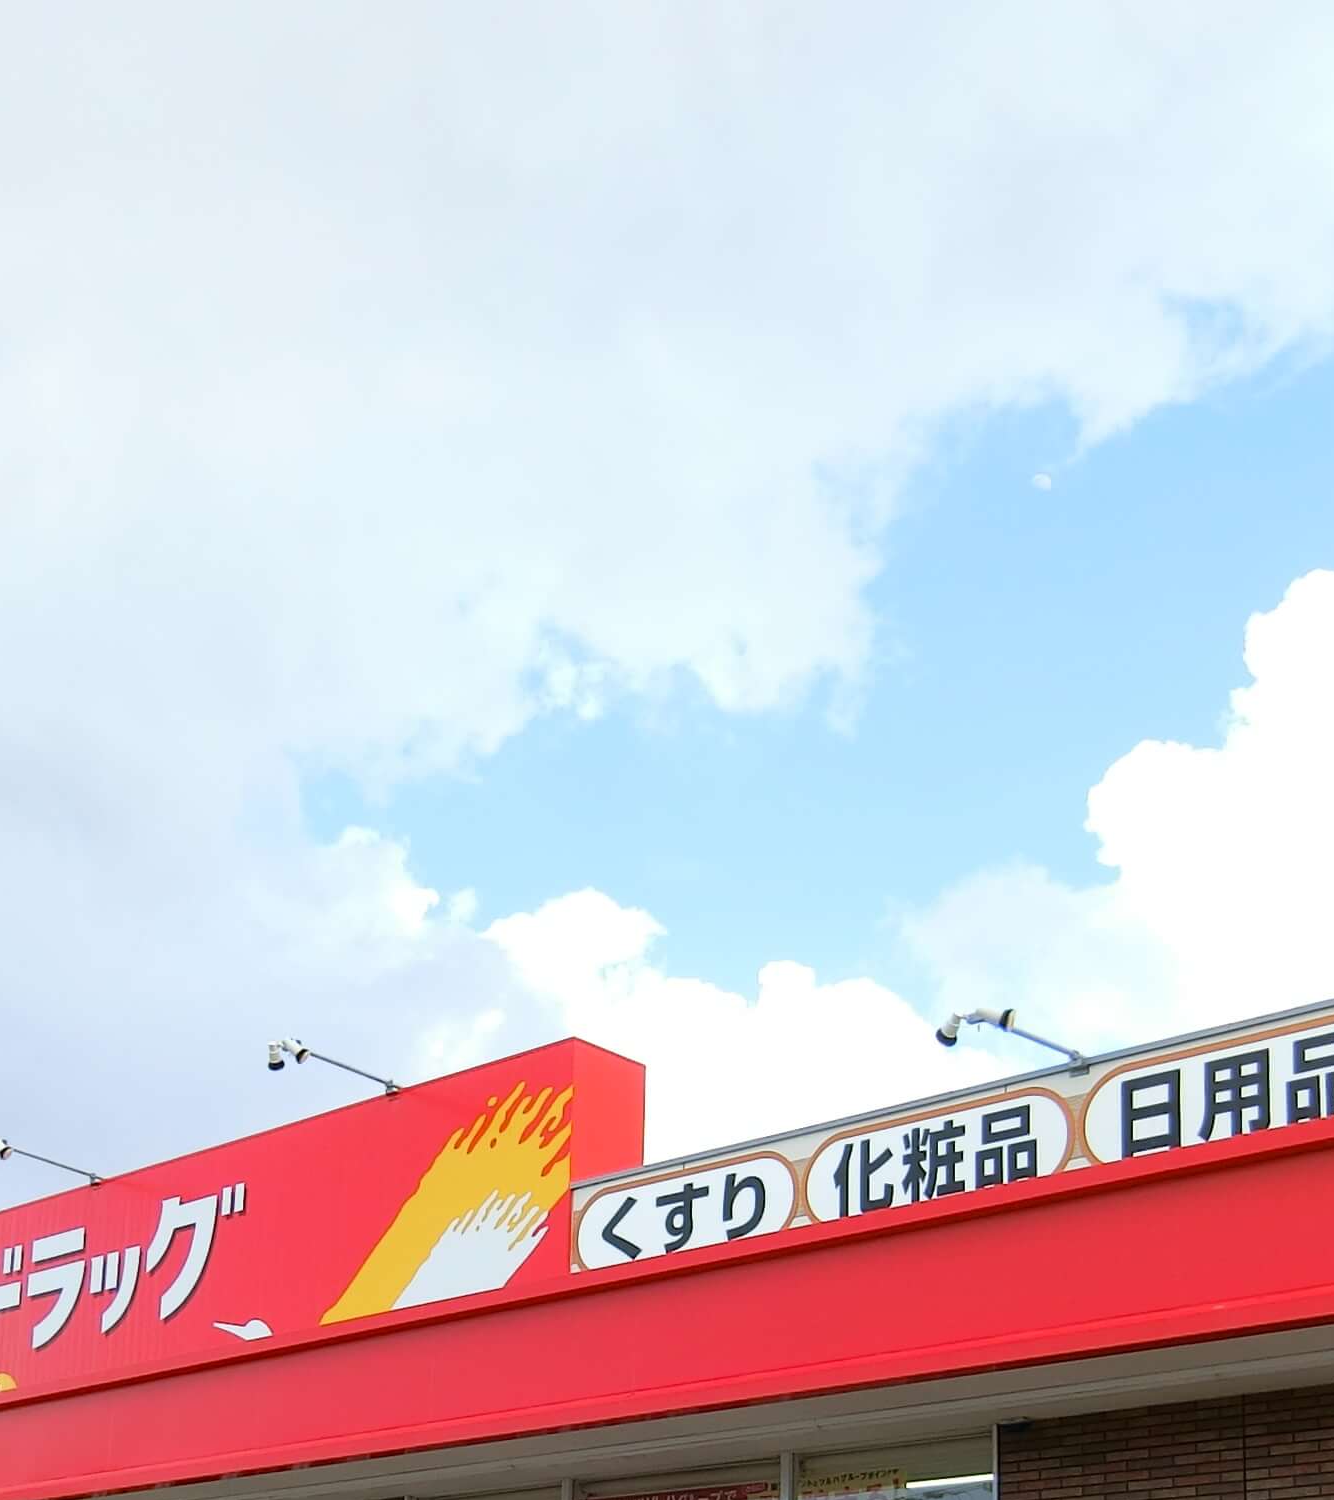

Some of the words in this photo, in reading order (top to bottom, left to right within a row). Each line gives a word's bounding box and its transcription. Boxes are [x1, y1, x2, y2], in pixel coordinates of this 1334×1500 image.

[831, 1103, 1040, 1218] 化粧品
[599, 1167, 768, 1262] くすり
